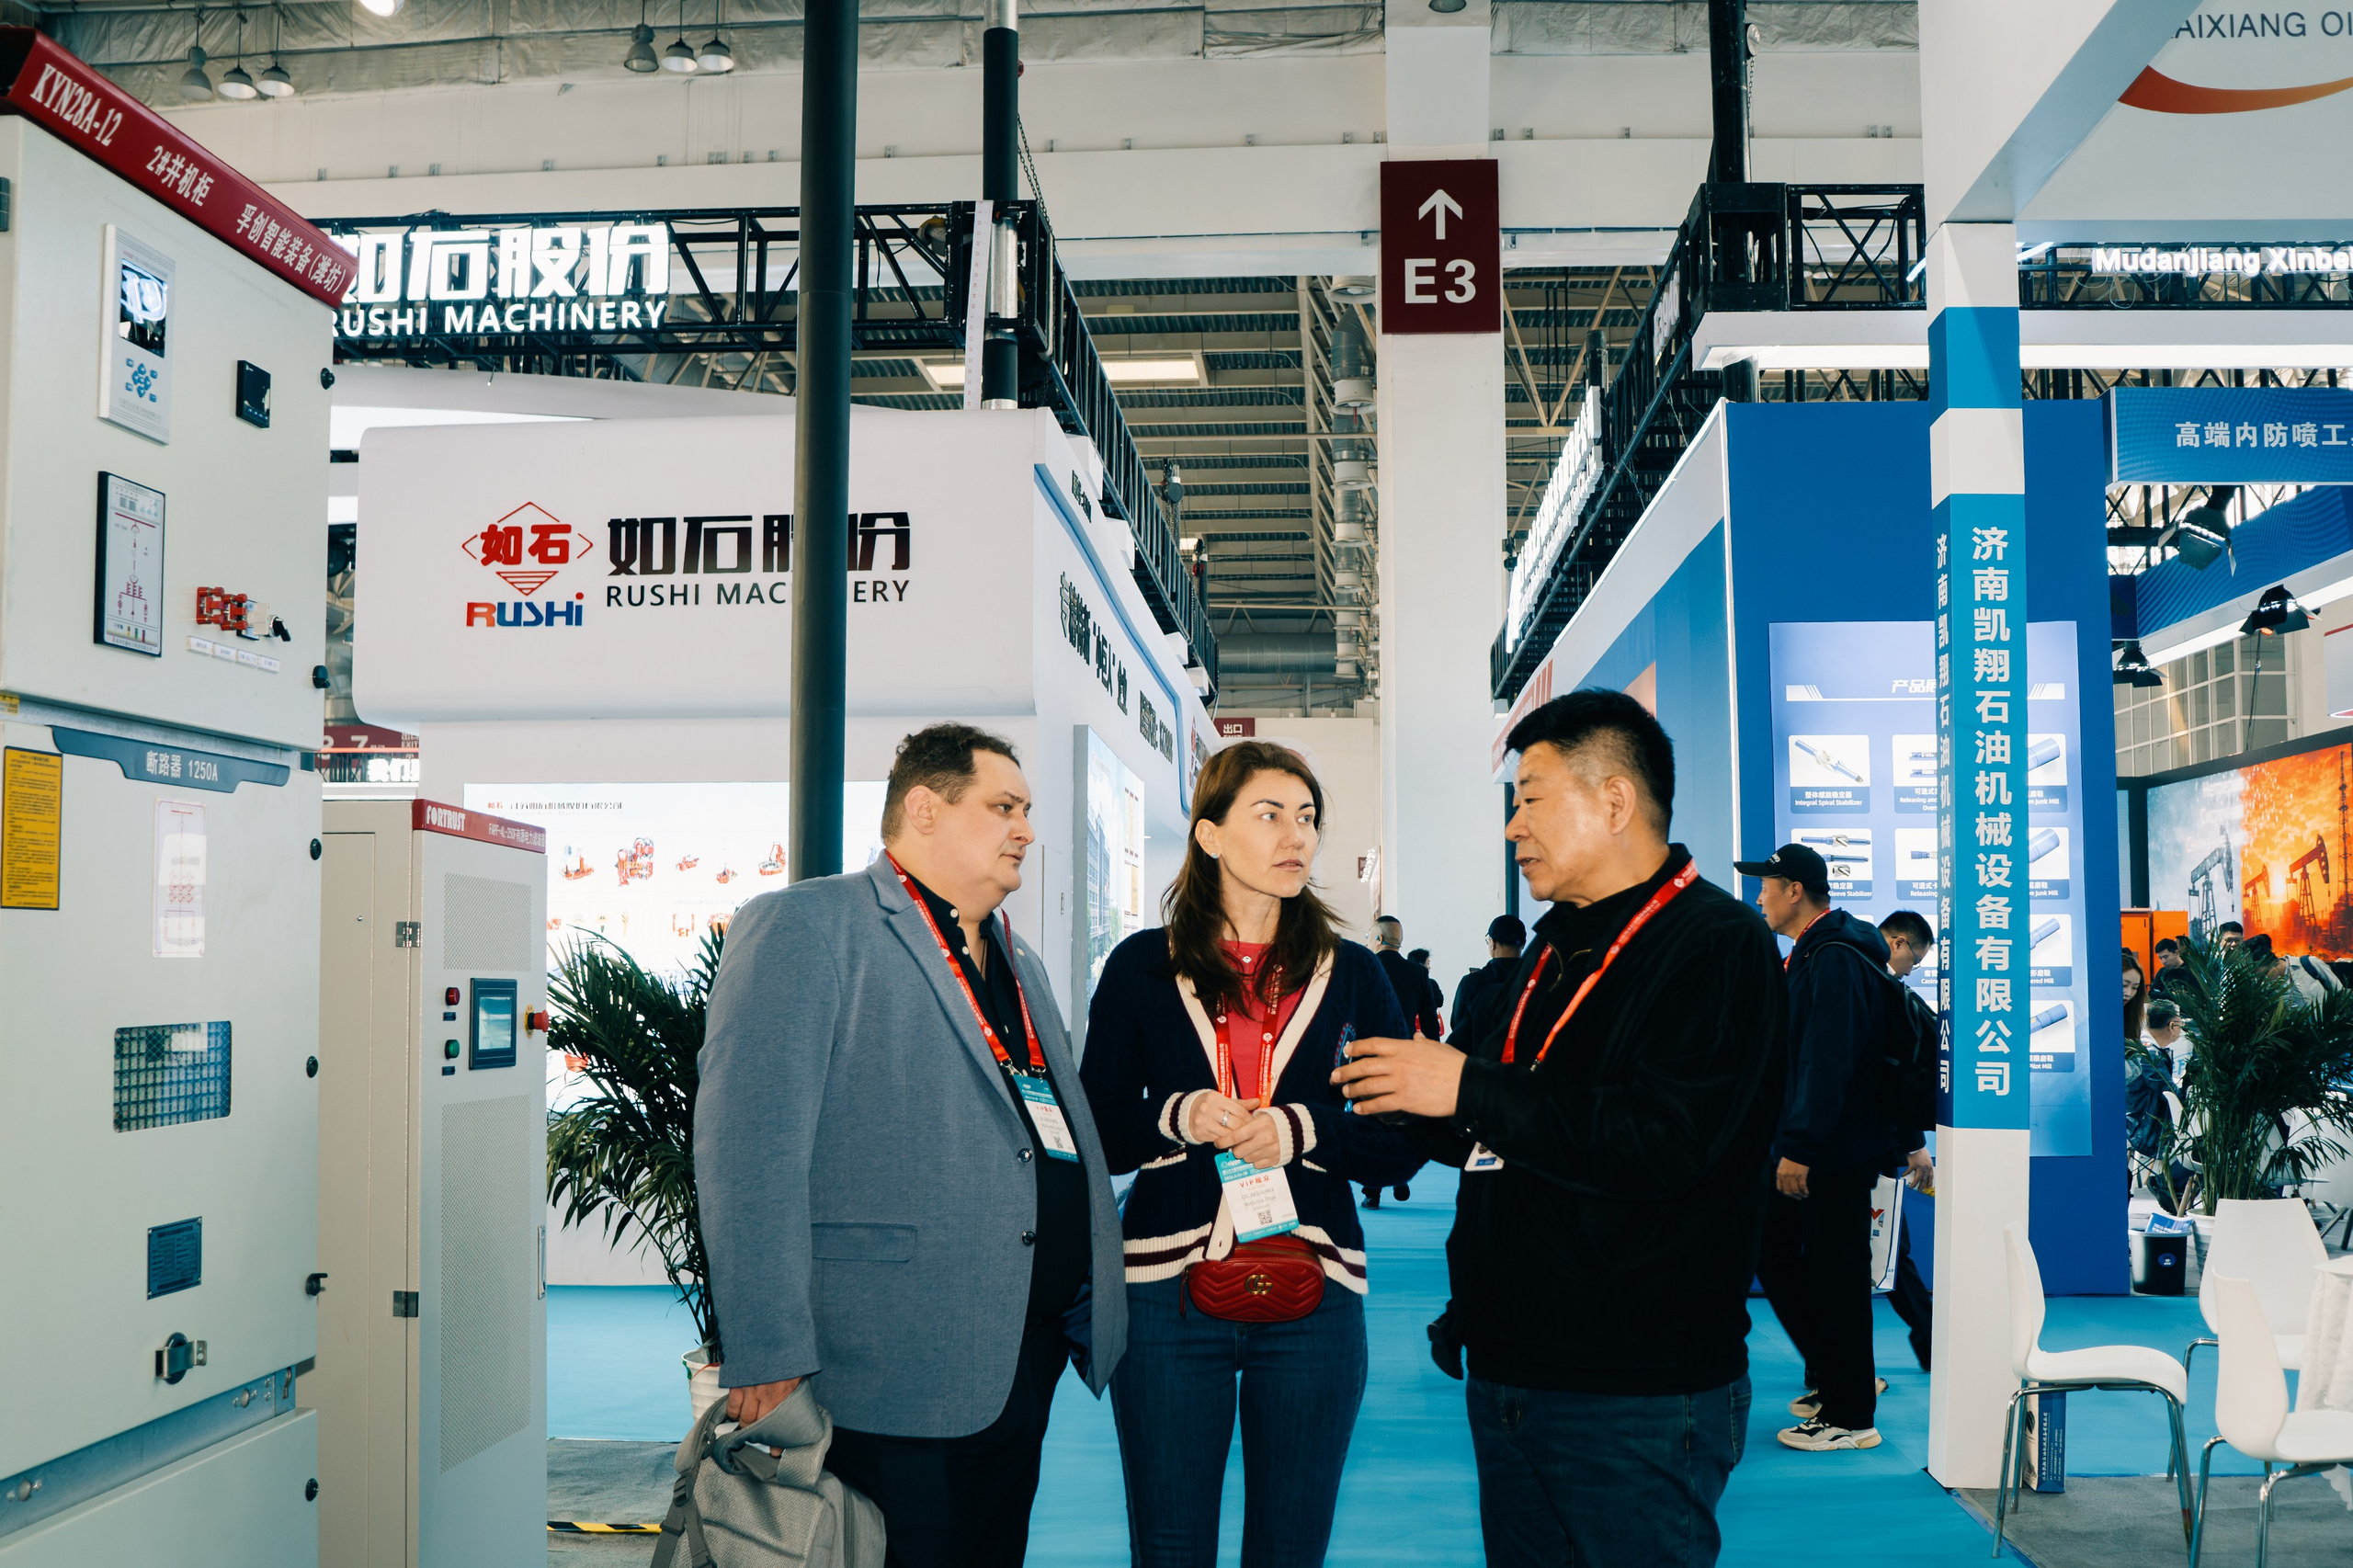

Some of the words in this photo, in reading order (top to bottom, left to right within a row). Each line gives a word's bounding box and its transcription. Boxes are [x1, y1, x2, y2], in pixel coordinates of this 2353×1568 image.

[2171, 12, 2306, 39] AIXIANG
[30, 63, 123, 147] KYN28A-12
[146, 146, 214, 206] 2#并机柜
[2094, 246, 2261, 277] Mudanjiang
[1404, 258, 1476, 304] E3
[444, 301, 667, 333] MACHINERY
[480, 523, 572, 566] 如石
[607, 583, 700, 607] RUSHI
[717, 579, 911, 605] MACERY
[1222, 723, 1243, 734] 出口
[146, 750, 181, 778] 断路器
[188, 759, 219, 781] 1250A
[426, 805, 466, 832] FORTRUST
[1937, 533, 1950, 1094] 济南凯翔石油机械设备有限公司
[1972, 527, 2013, 1096] 济南凯翔石油机械设备有限公司
